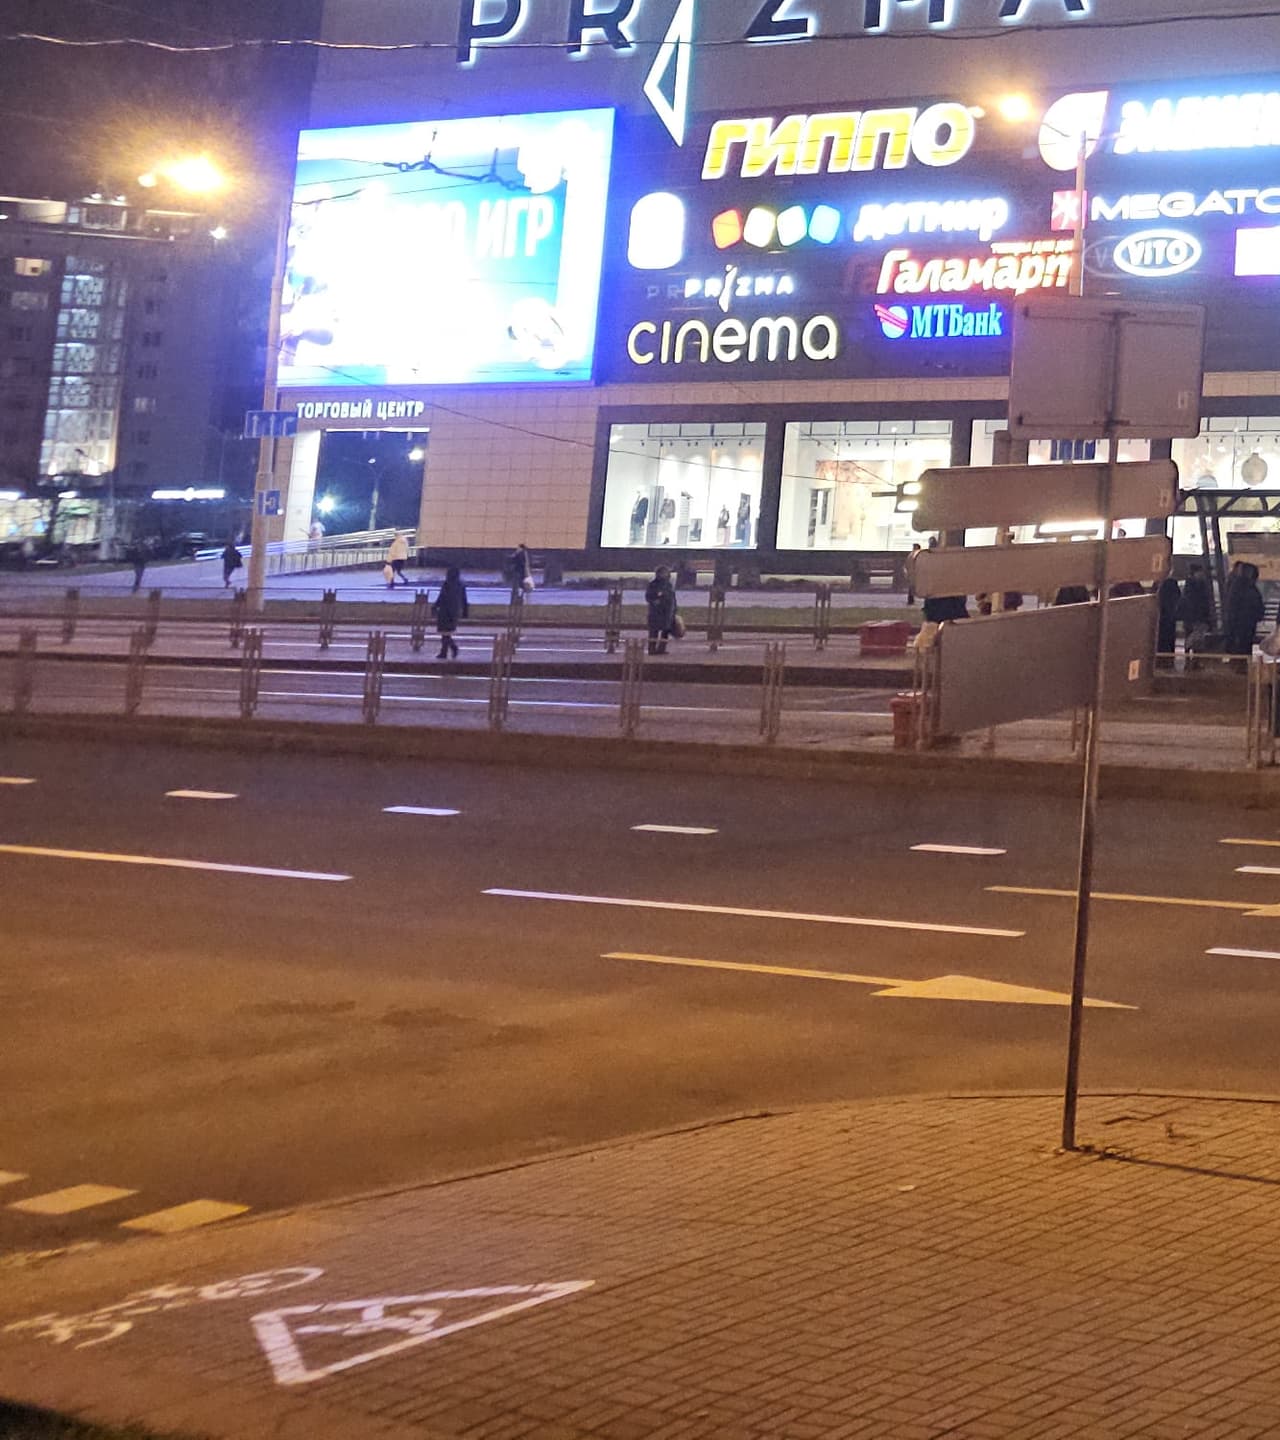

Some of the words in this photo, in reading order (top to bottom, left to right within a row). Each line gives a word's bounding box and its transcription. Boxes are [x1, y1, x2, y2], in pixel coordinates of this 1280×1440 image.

[701, 103, 974, 179] ГИППО
[476, 196, 555, 258] ИГР
[627, 316, 838, 364] cinema
[910, 303, 1003, 338] МТБанк
[296, 399, 372, 419] ТОРГОВЫЙ
[376, 401, 424, 420] ЦЕНТР
